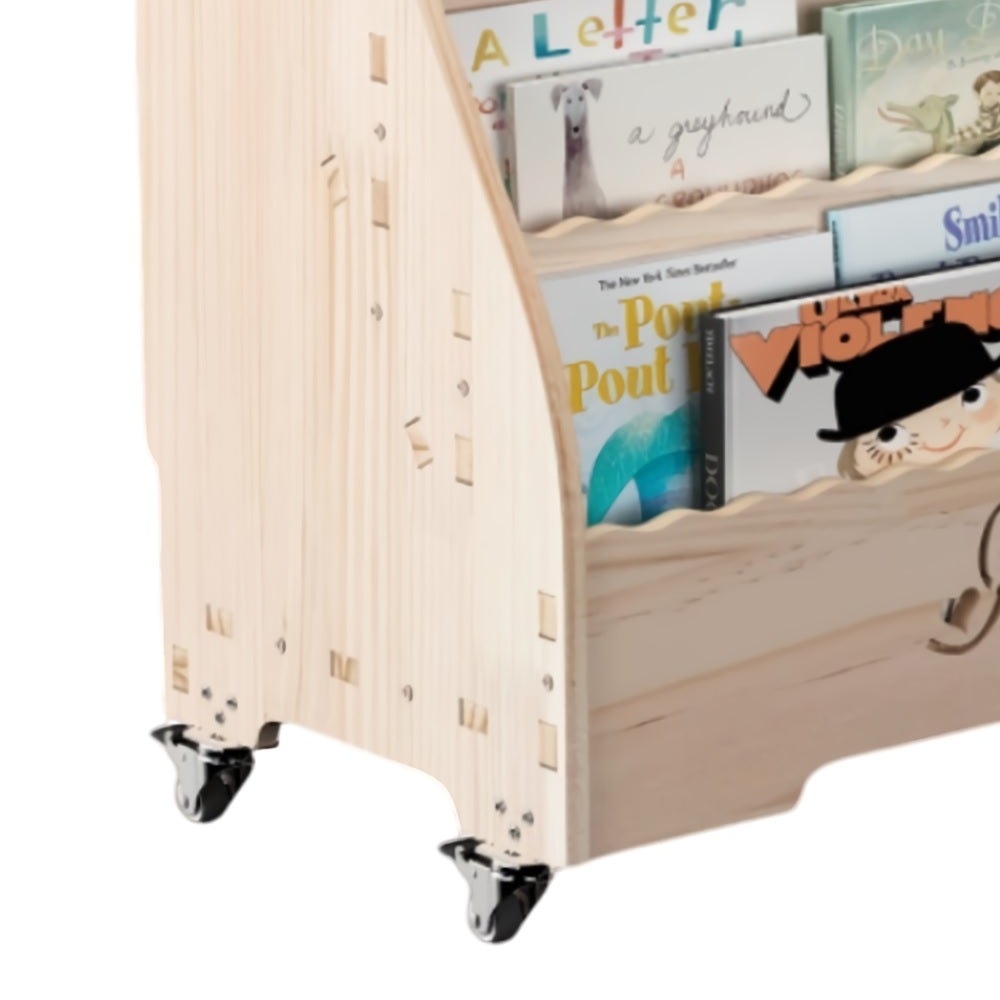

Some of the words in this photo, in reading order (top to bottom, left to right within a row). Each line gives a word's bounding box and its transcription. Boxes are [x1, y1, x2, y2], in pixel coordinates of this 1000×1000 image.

[471, 28, 510, 73] A
[628, 125, 653, 145] a
[663, 89, 812, 163] greyhound
[670, 157, 686, 180] A
[592, 322, 620, 340] The
[565, 344, 675, 414] Pout
